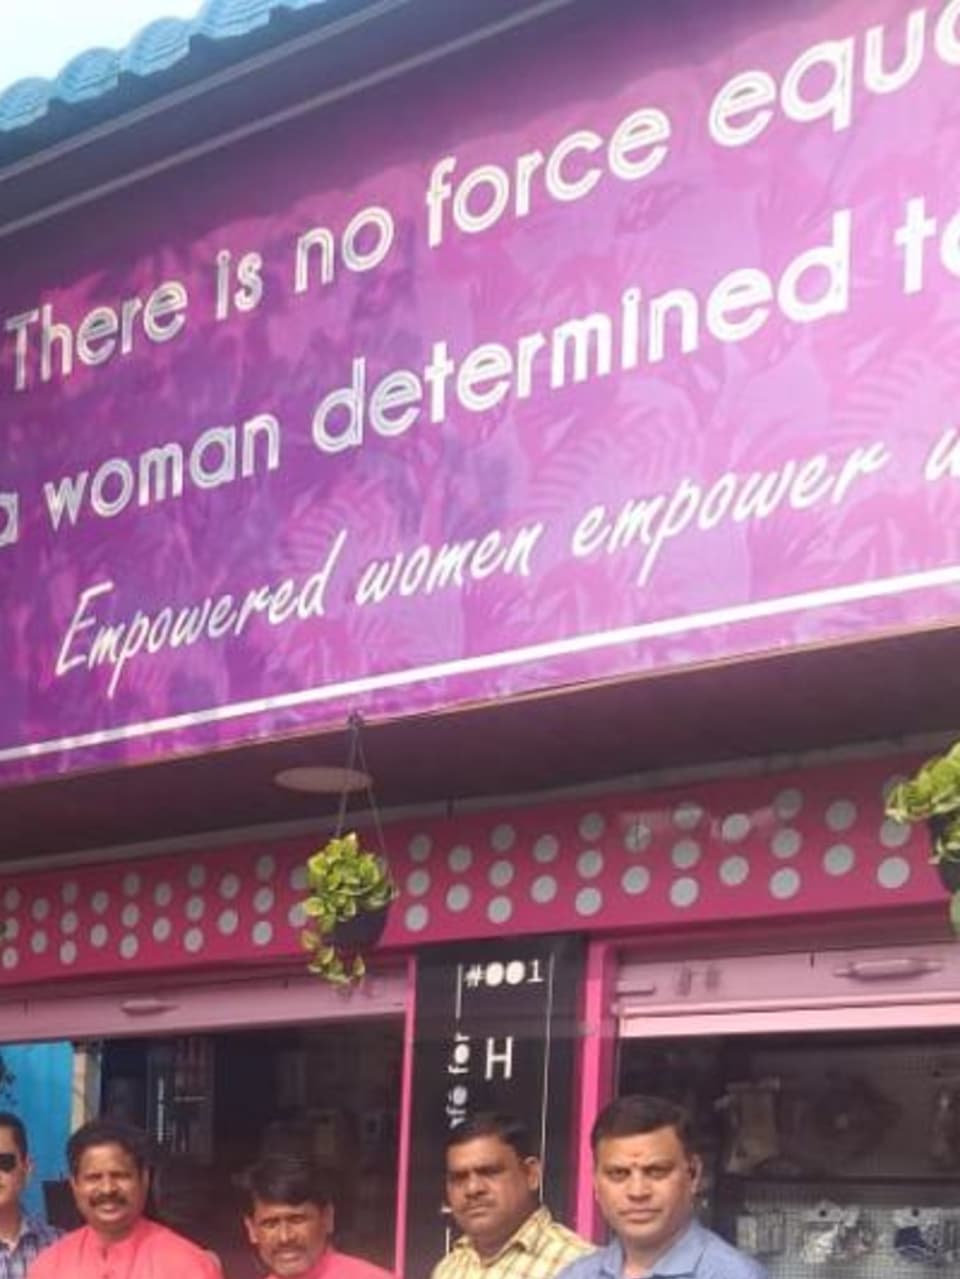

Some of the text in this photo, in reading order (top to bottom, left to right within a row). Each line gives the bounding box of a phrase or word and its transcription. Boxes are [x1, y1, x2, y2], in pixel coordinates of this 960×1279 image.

[4, 281, 188, 390] There
[215, 249, 263, 321] is
[294, 206, 394, 293] no
[426, 107, 671, 248] force
[44, 413, 280, 532] woman
[311, 208, 852, 453] determined
[893, 196, 960, 295] t
[55, 441, 892, 698] Empowered women empower
[448, 1032, 470, 1075] for
